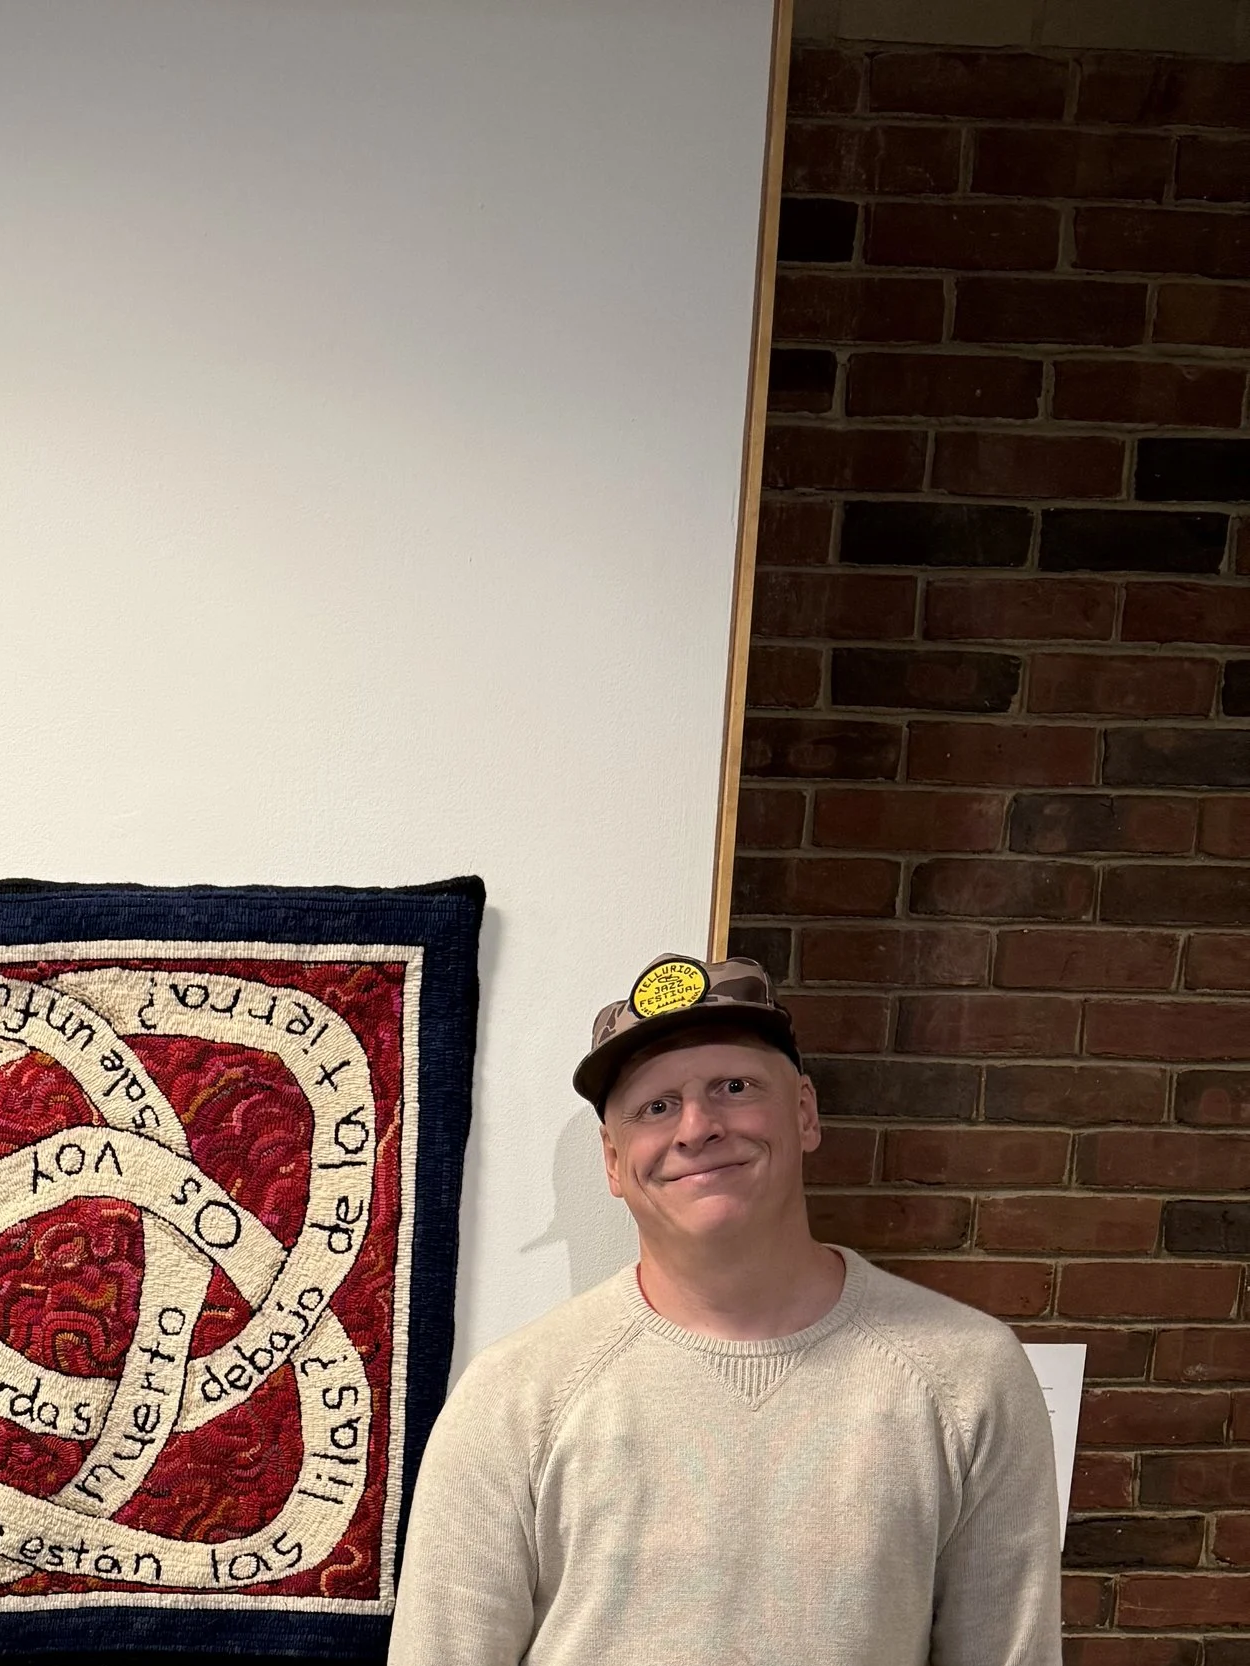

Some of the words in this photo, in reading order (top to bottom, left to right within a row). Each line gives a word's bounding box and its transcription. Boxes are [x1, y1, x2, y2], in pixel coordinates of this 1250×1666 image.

[638, 964, 698, 994] TELLURIDE
[639, 984, 702, 1008] FESTIVAL
[654, 979, 685, 995] JAZZ
[45, 997, 97, 1051] un
[137, 977, 352, 1092] tierra?
[100, 1049, 162, 1131] sale
[33, 1140, 123, 1195] voy
[317, 1104, 369, 1169] la
[171, 1176, 242, 1250] Os
[307, 1195, 365, 1254] de
[201, 1287, 325, 1402] debajo
[75, 1306, 187, 1503] muerto
[21, 1536, 164, 1582] están
[210, 1531, 304, 1585] las
[296, 1354, 362, 1506] lilas?
